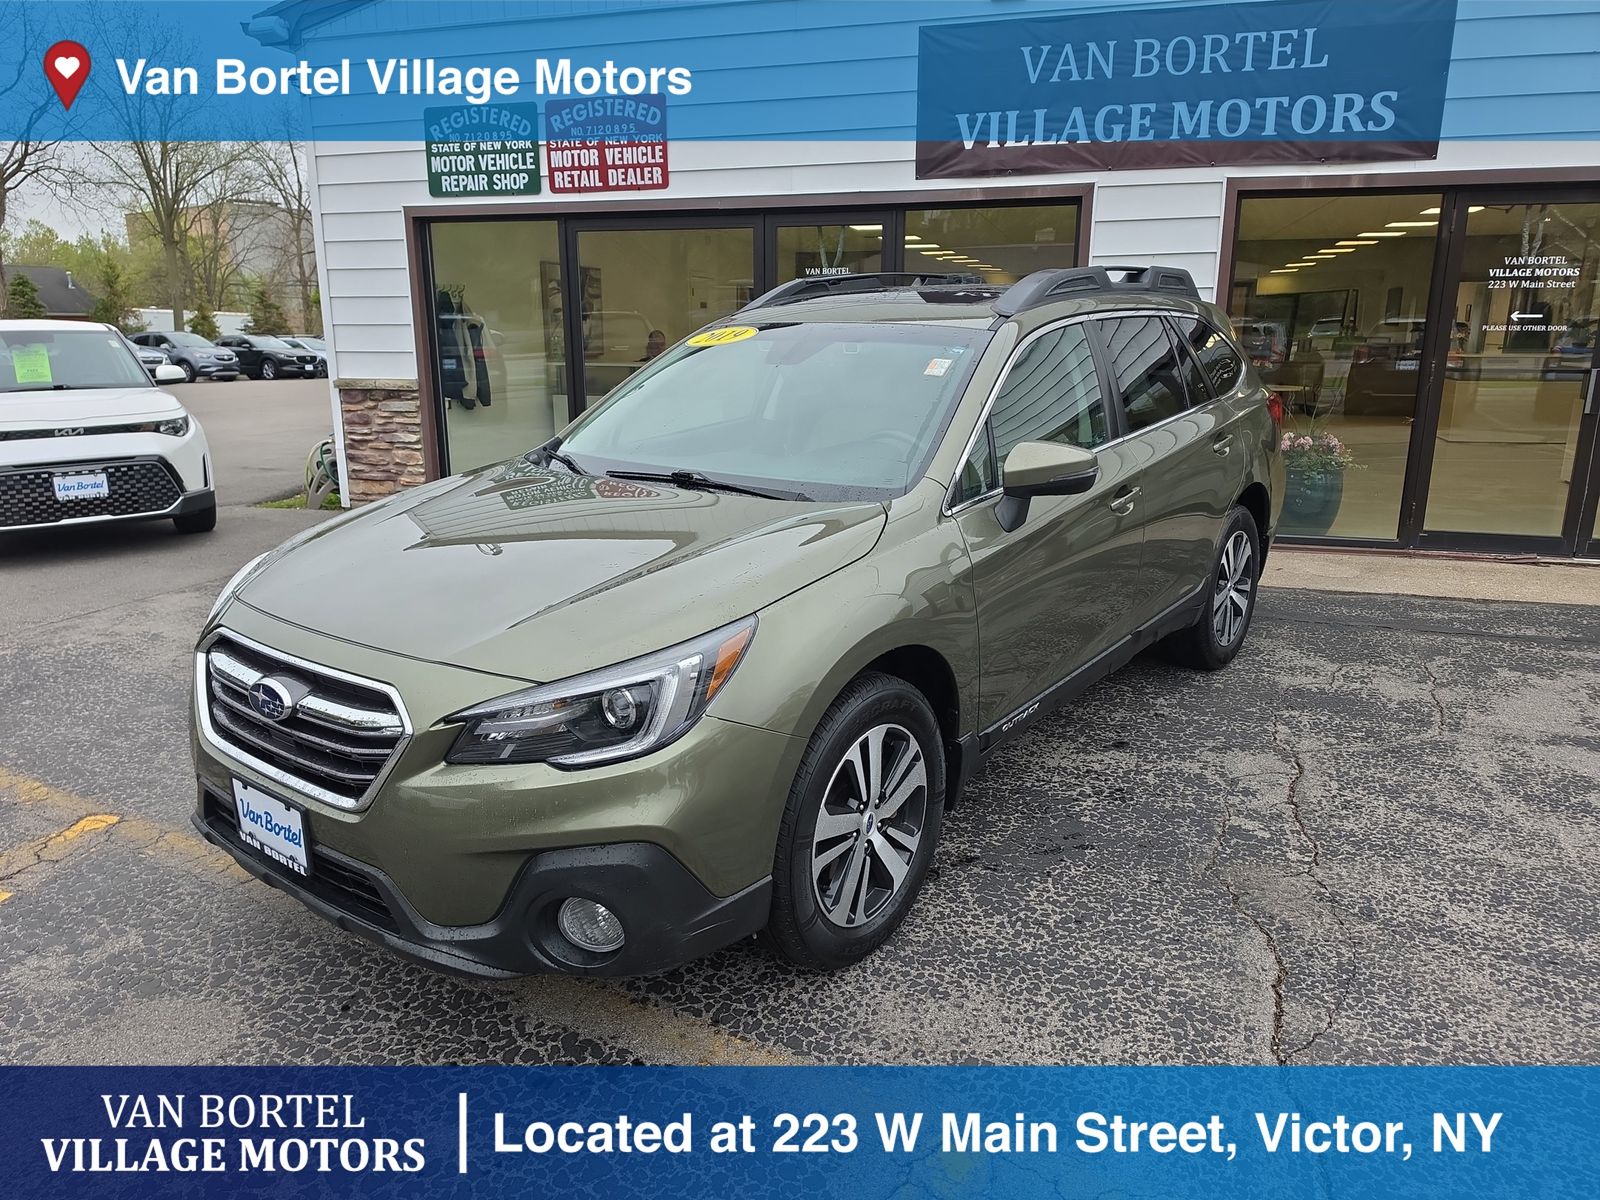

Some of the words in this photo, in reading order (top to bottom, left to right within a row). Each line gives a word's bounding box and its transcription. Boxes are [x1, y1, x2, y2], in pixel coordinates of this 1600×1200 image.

[1021, 41, 1117, 84] VAN
[1134, 28, 1329, 77] BORTEL
[429, 106, 531, 142] REGISTERED
[550, 98, 662, 133] REGISTERED
[955, 104, 1156, 150] VILLAGE
[1172, 91, 1399, 140] MOTORS
[586, 123, 636, 135] 7120895
[431, 143, 460, 153] STATE
[464, 143, 476, 151] OF
[479, 141, 502, 150] NEW
[505, 140, 533, 150] YORK
[549, 139, 581, 149] STATE
[586, 138, 600, 147] OF
[605, 136, 630, 145] NEW
[634, 133, 663, 144] YORK
[431, 155, 475, 173] MOTOR
[478, 152, 535, 171] VEHICLE
[550, 150, 599, 168] MOTOR
[604, 146, 663, 165] VEHICLE
[441, 174, 488, 192] REPAIR
[493, 172, 529, 190] SHOP
[554, 171, 602, 189] RETAIL
[608, 167, 663, 186] DEALER
[1504, 256, 1525, 265] VAN
[1527, 256, 1568, 265] BORTEL
[805, 267, 821, 275] VAN
[822, 267, 851, 275] BORTEL
[1488, 268, 1533, 277] VILLAGE
[1534, 267, 1580, 277] MOTORS
[1488, 280, 1506, 289] 223
[1508, 280, 1520, 288] W
[1520, 280, 1544, 288] Main
[1546, 279, 1576, 288] Street
[57, 484, 76, 493] Van
[76, 480, 104, 490] Bortel
[240, 798, 264, 828] Van
[264, 811, 302, 848] Bortel
[239, 831, 261, 850] VAN
[263, 845, 307, 877] BORTEL
